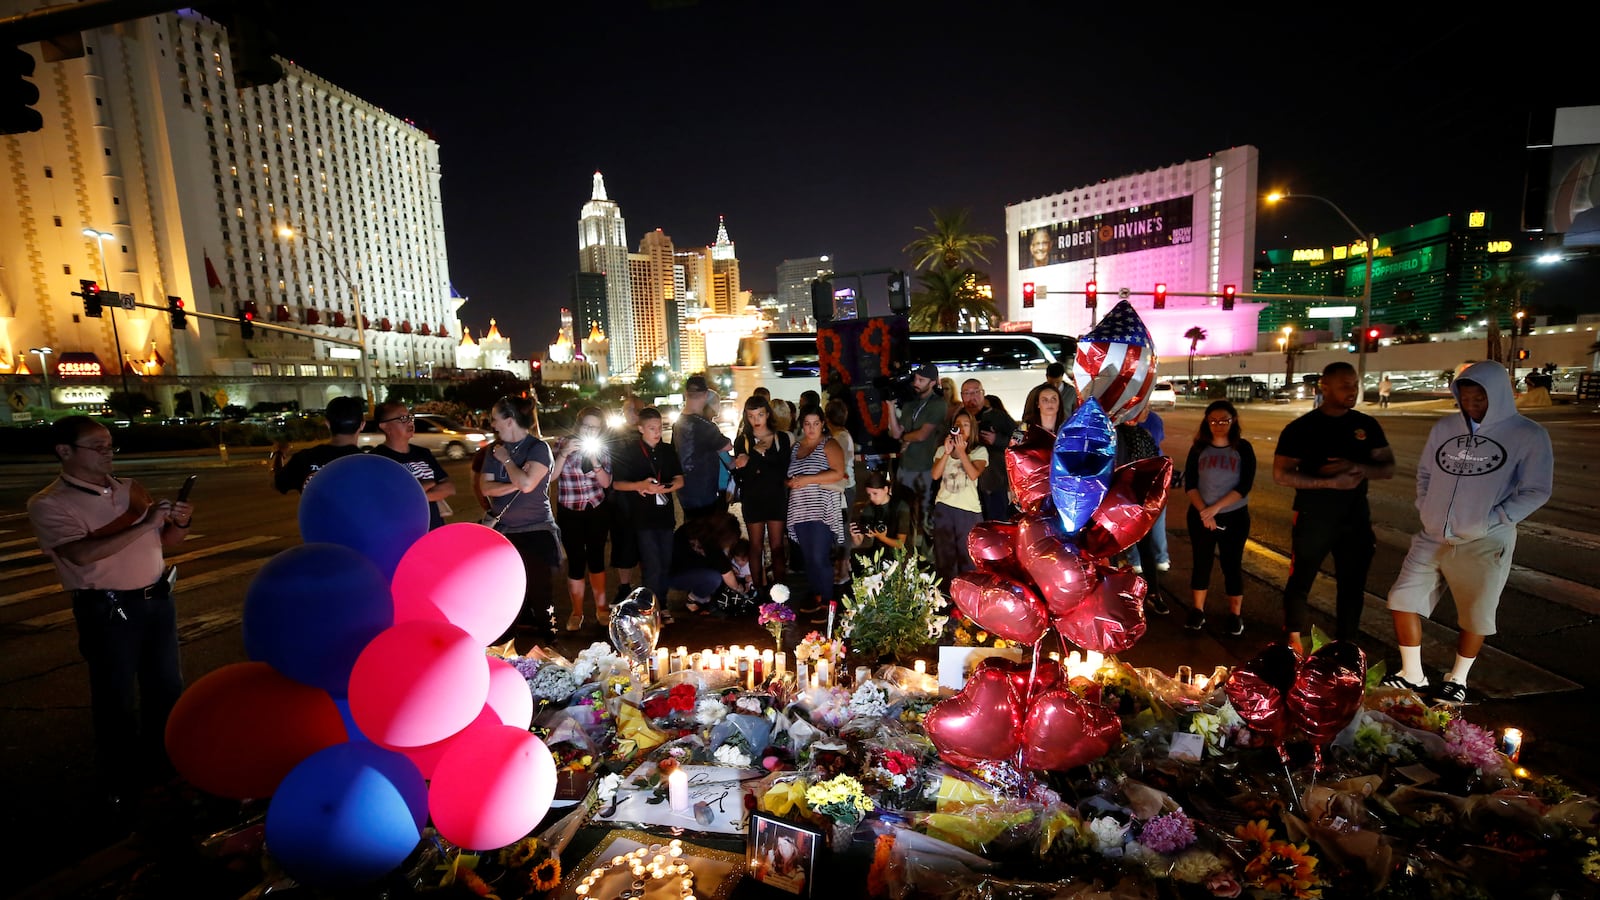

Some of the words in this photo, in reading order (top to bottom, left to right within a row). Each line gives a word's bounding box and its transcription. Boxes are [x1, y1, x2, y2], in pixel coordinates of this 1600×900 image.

[1113, 217, 1163, 239] IRVINE'S
[1172, 226, 1192, 238] NOW
[1457, 437, 1487, 448] FLY
[1199, 455, 1237, 473] UNLV
